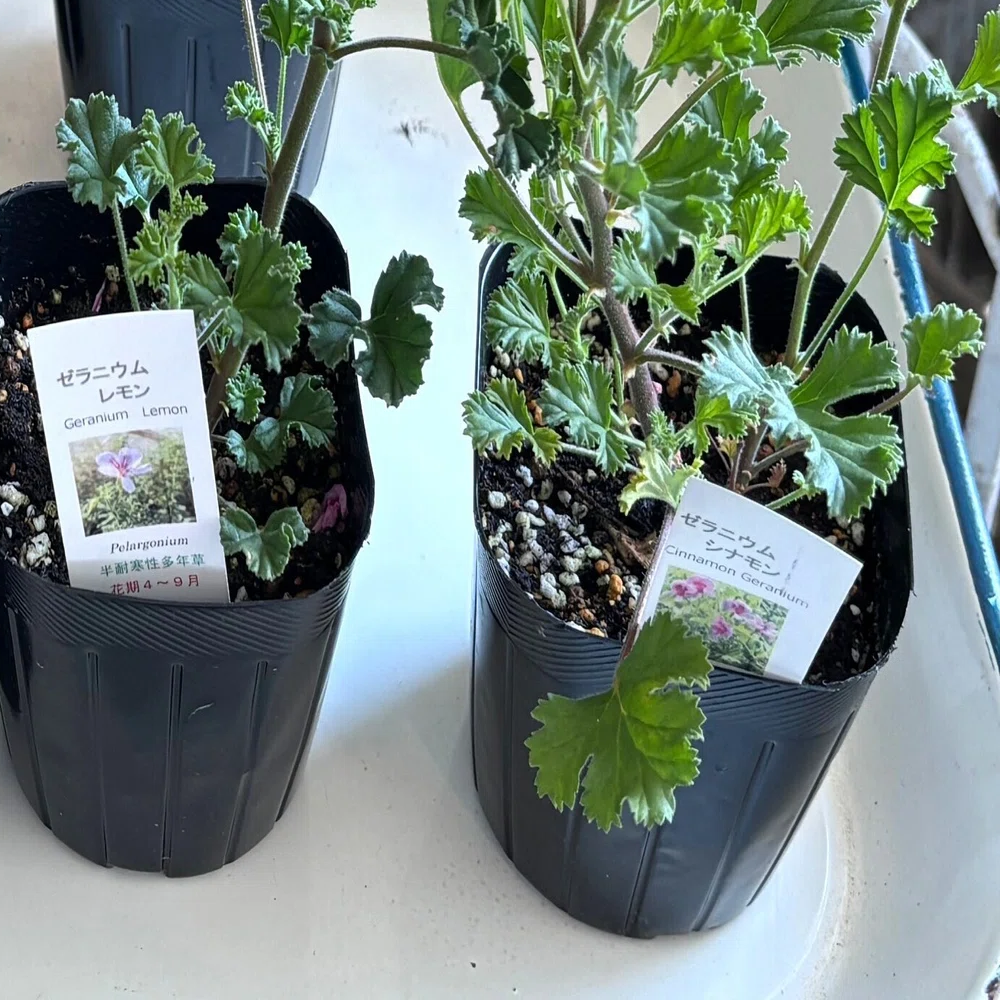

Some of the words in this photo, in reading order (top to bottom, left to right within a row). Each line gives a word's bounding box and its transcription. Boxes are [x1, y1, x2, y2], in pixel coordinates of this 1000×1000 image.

[56, 360, 149, 388] ゼラニウム
[98, 384, 151, 404] レモン
[63, 409, 129, 430] Geranium
[142, 403, 189, 419] Lemon
[110, 535, 189, 555] Pelargonium
[680, 513, 776, 561] ゼラニウム
[100, 553, 206, 577] 半耐寒性多年草
[705, 539, 781, 577] シナモン
[665, 545, 737, 577] Cinnamon
[740, 571, 810, 610] Geranium
